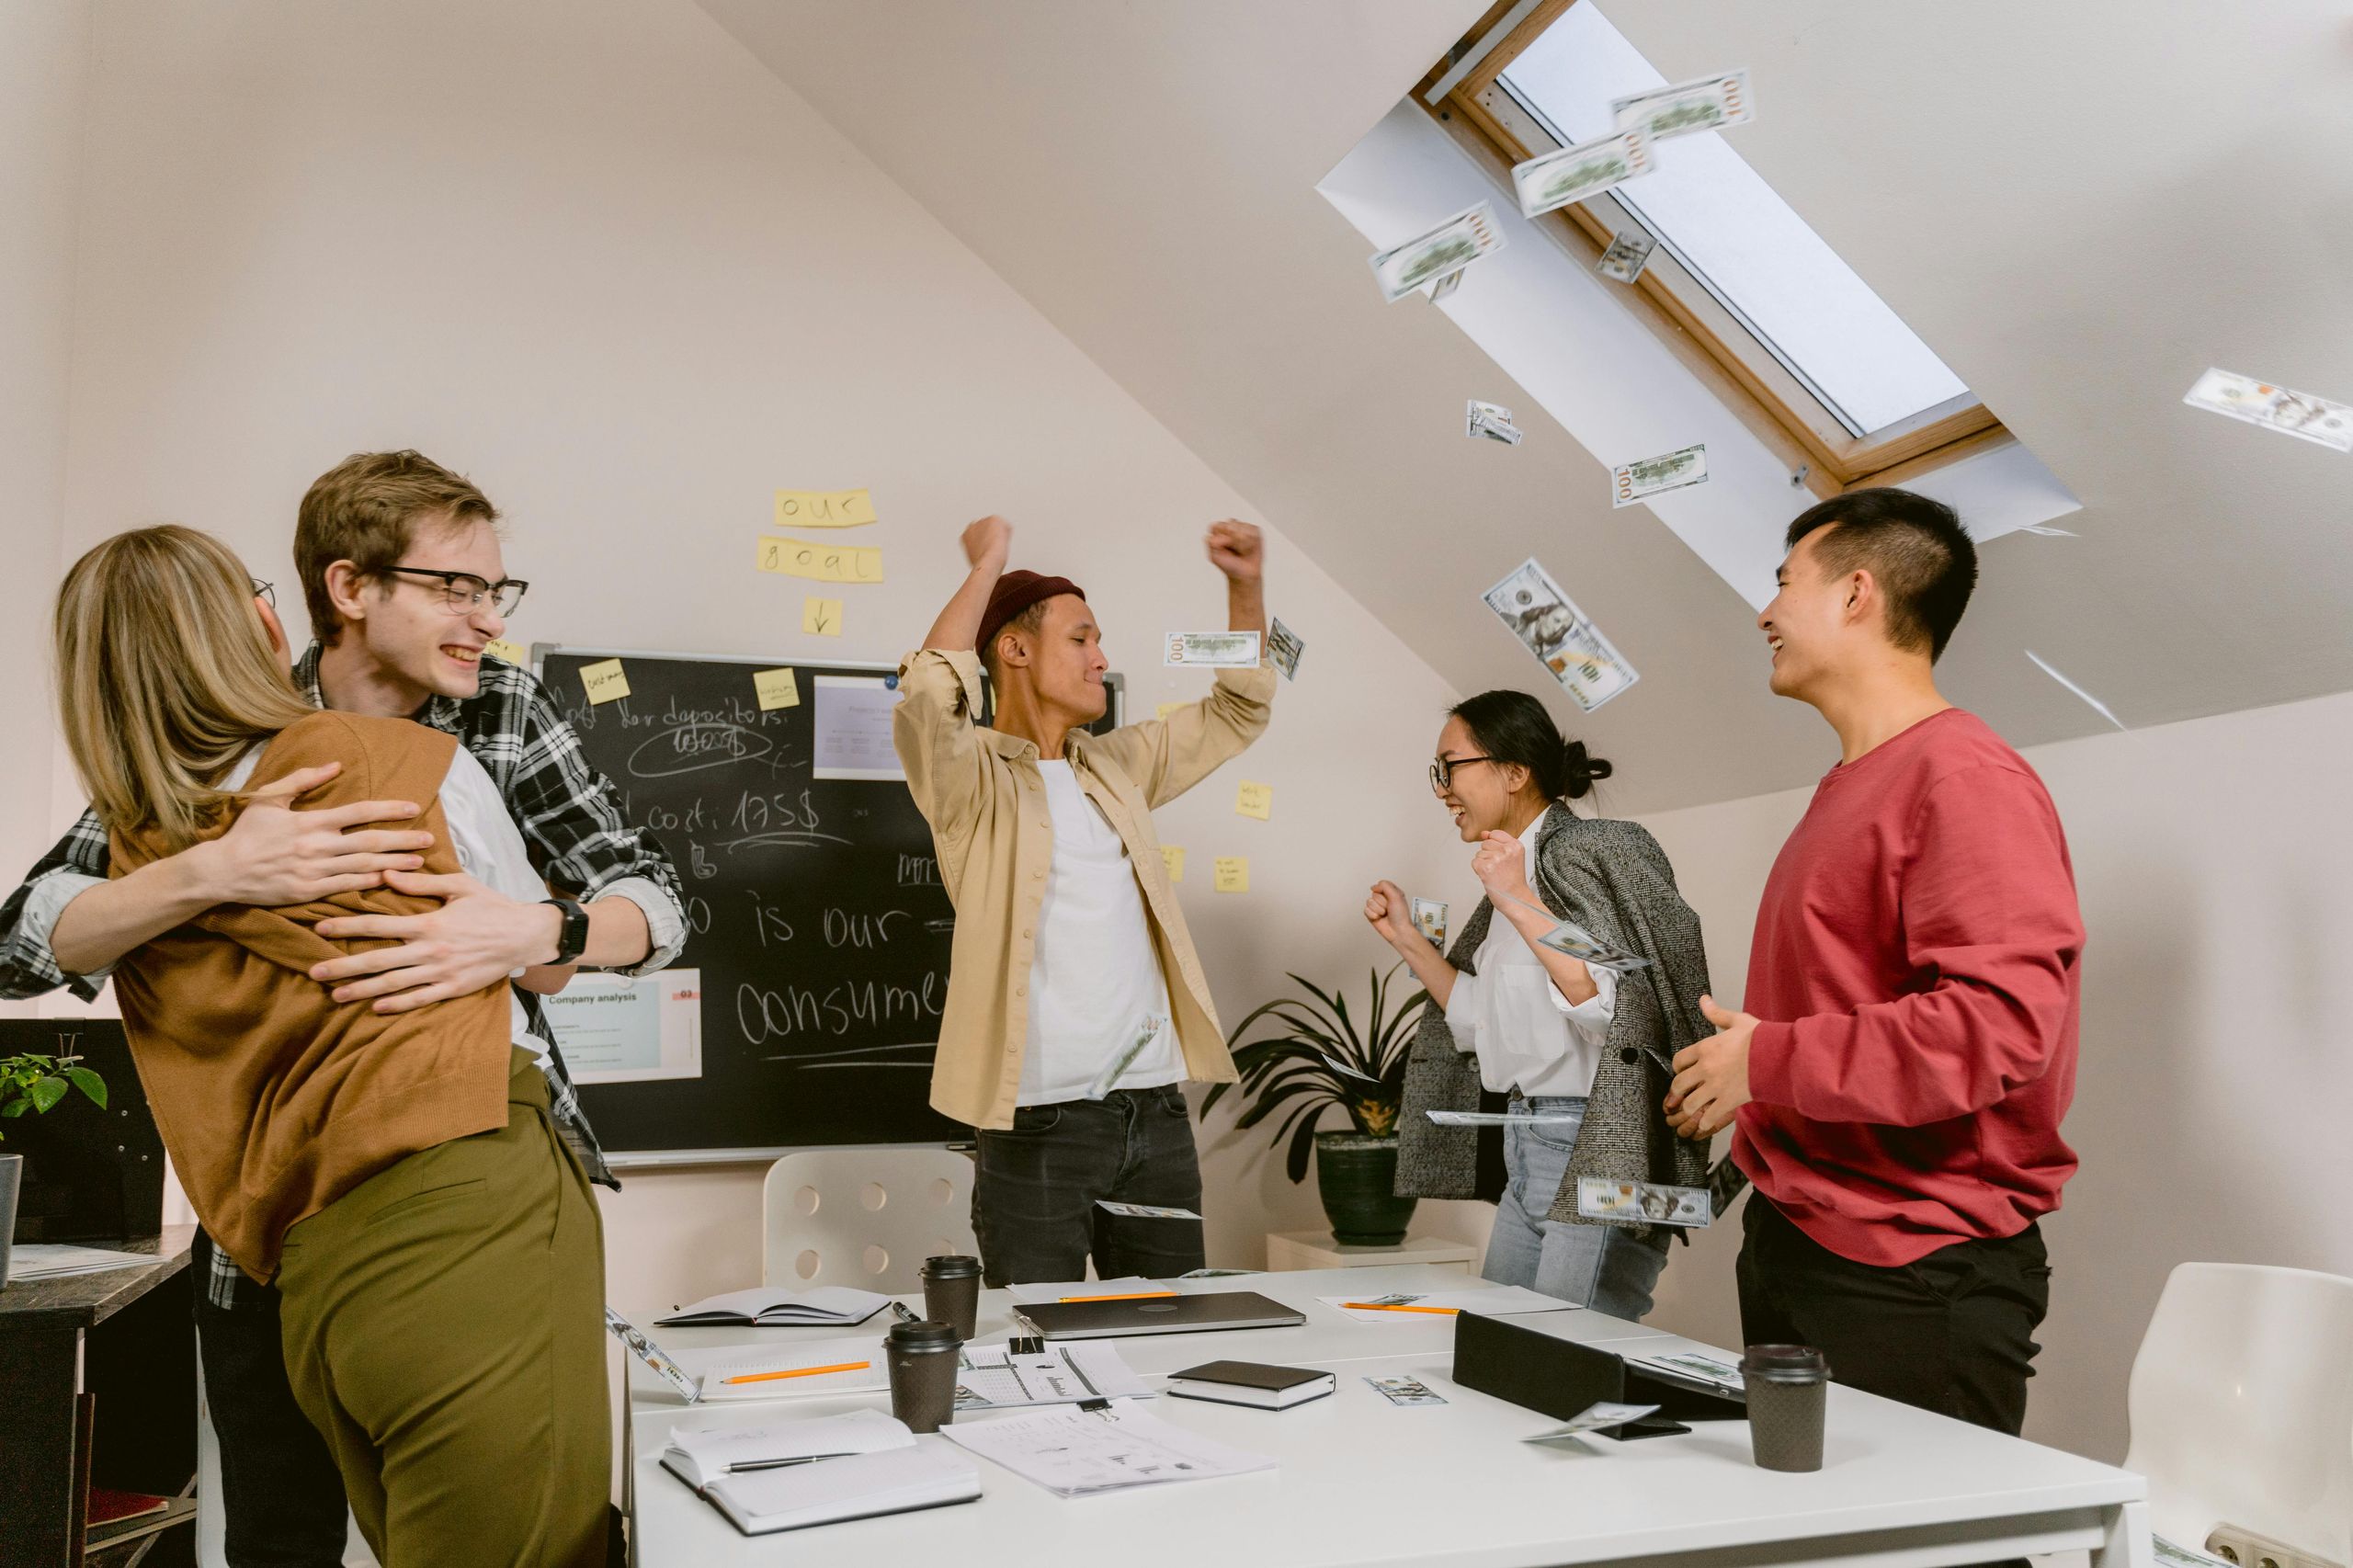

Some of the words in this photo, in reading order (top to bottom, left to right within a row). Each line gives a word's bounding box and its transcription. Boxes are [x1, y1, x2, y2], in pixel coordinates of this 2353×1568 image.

[1617, 468, 1632, 499] 100
[782, 496, 857, 520] our
[764, 544, 870, 579] goal
[1170, 635, 1185, 661] 100
[732, 789, 821, 837] 175$
[745, 890, 794, 948] is
[549, 995, 596, 1006] Company
[597, 993, 637, 1004] analysis
[680, 990, 692, 998] 03
